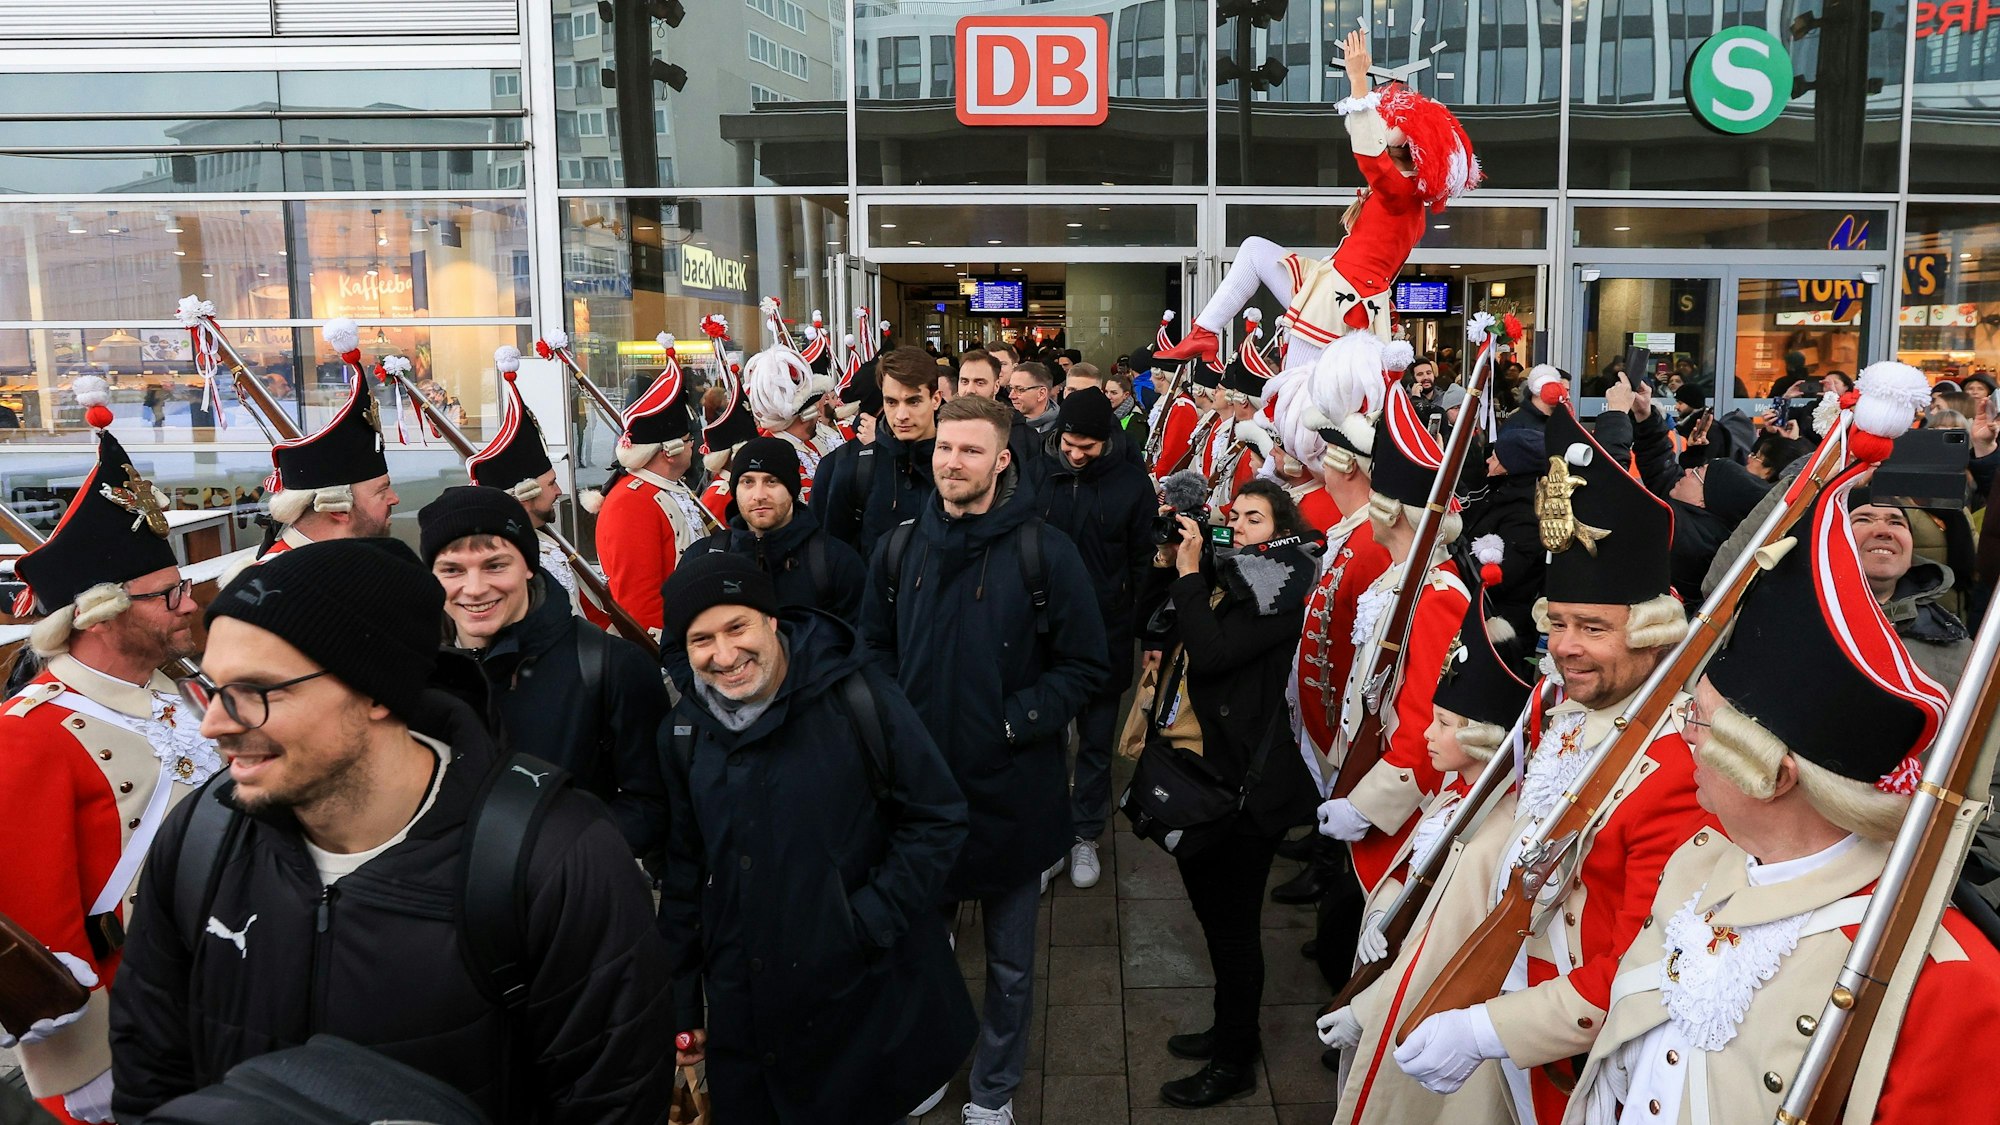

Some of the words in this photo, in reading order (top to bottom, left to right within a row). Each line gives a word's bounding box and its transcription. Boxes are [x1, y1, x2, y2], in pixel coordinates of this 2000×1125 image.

[977, 35, 1089, 106] DB
[1711, 37, 1774, 121] S
[684, 248, 747, 291] backWERK
[338, 274, 413, 301] Kaffeeba
[1681, 295, 1693, 310] S
[1267, 535, 1301, 549] LUMIX
